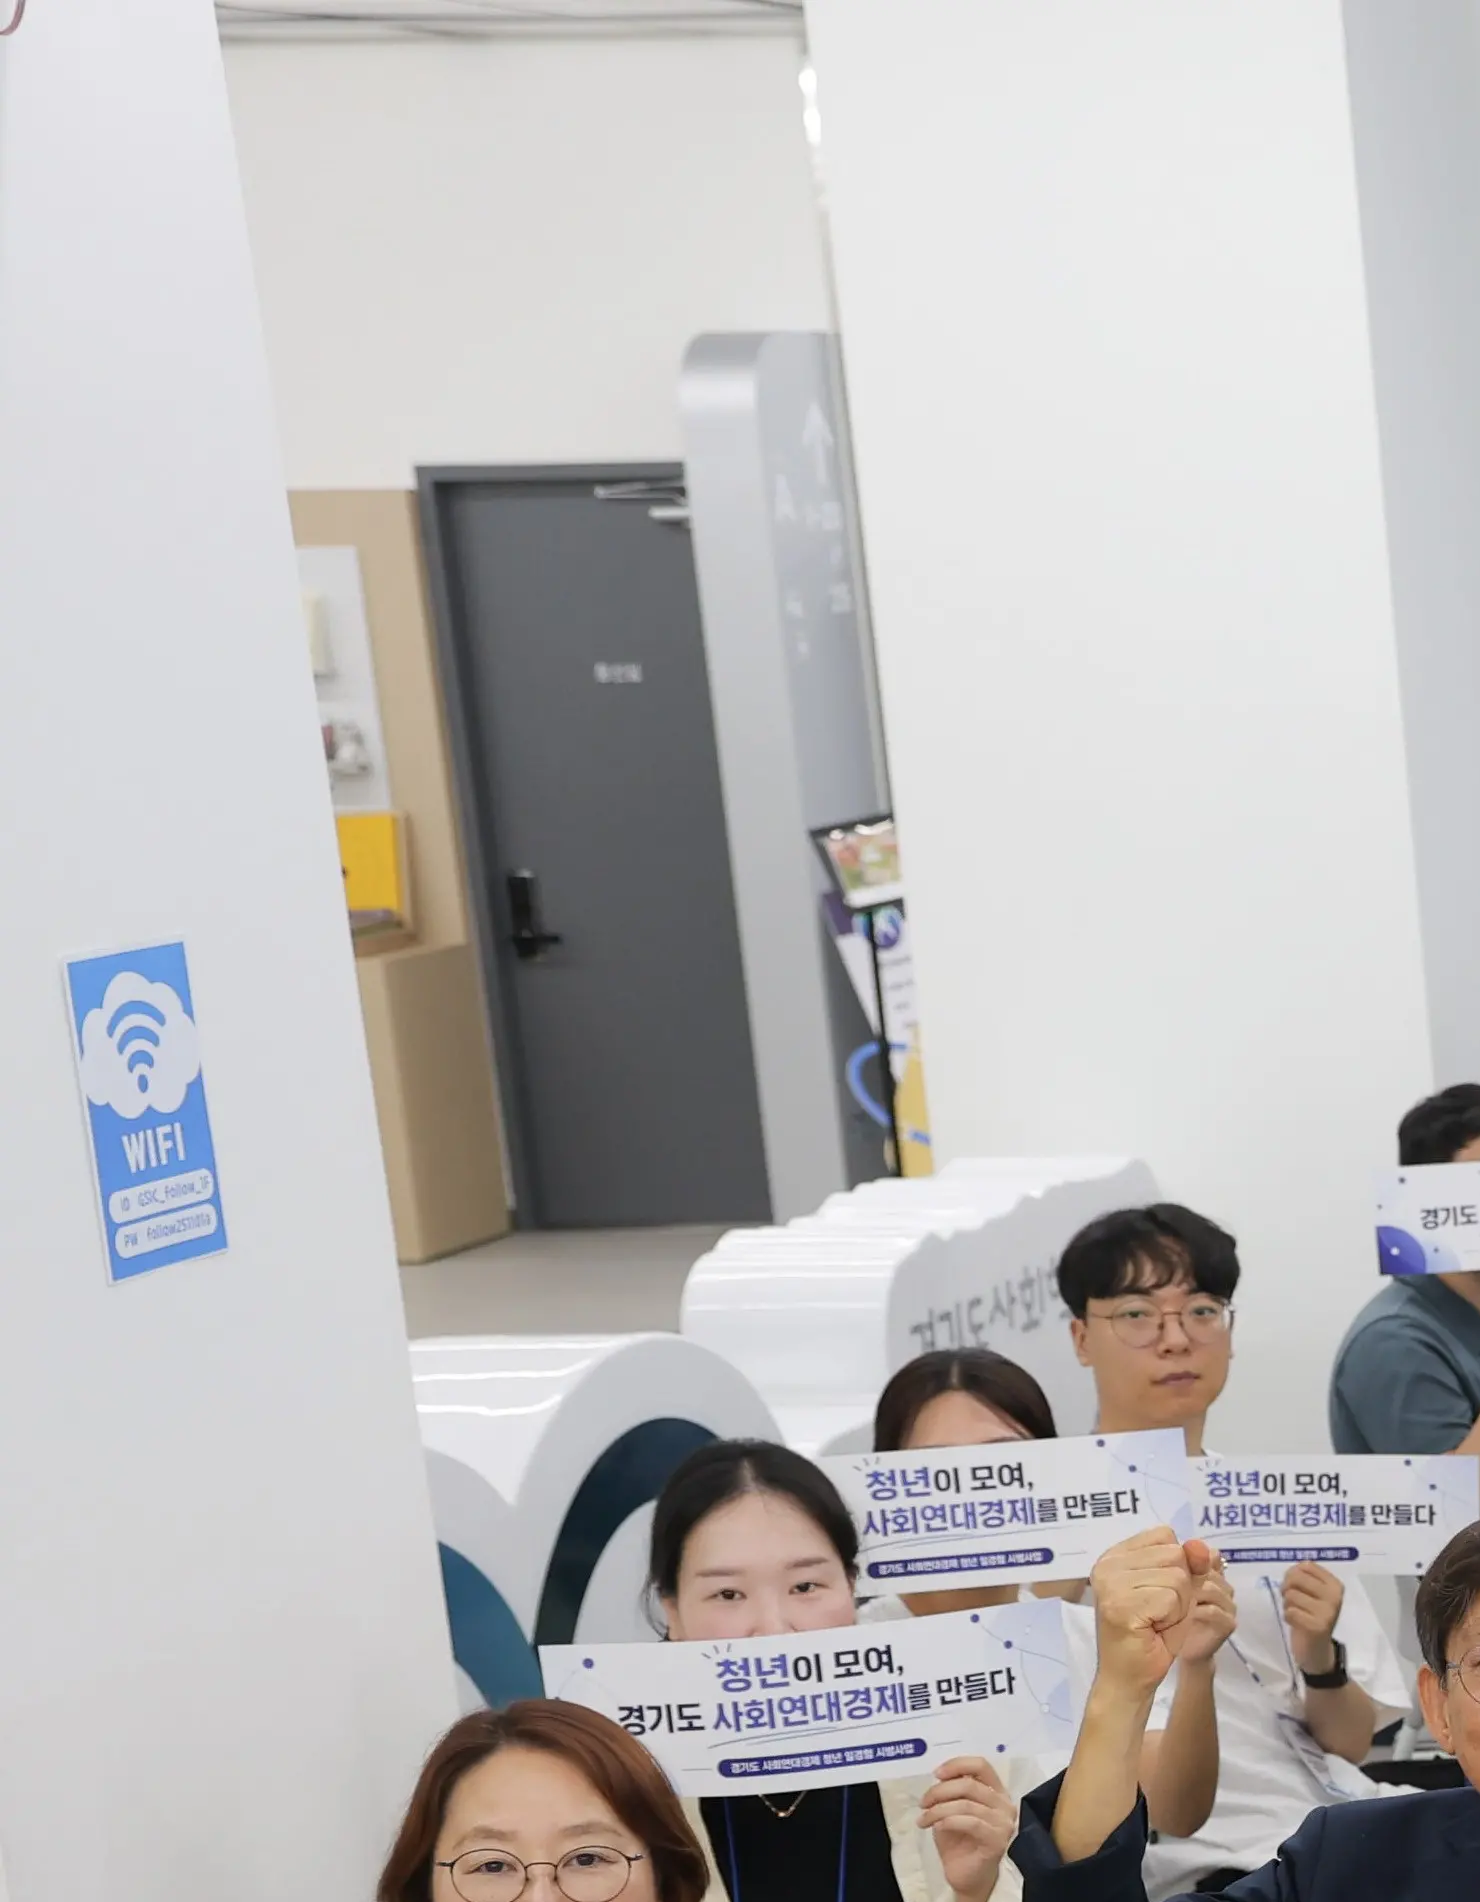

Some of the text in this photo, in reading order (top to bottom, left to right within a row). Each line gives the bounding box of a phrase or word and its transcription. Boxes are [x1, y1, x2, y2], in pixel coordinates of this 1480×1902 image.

[122, 1122, 186, 1174] WIFI
[1421, 1205, 1479, 1229] 경기도
[866, 1462, 1033, 1501] 청년이 모여,
[1206, 1471, 1347, 1498] 청년이 모여,
[863, 1489, 1139, 1536] 사회연대경제를 만들다
[1199, 1502, 1436, 1528] 사회연대경제를 만들다
[717, 1644, 904, 1692] 청년이 모여,
[618, 1667, 1016, 1736] 경기도 사회연대경제를 만들다
[731, 1743, 914, 1773] 경기도 사회연대경제 청년 일경험 시범사업
